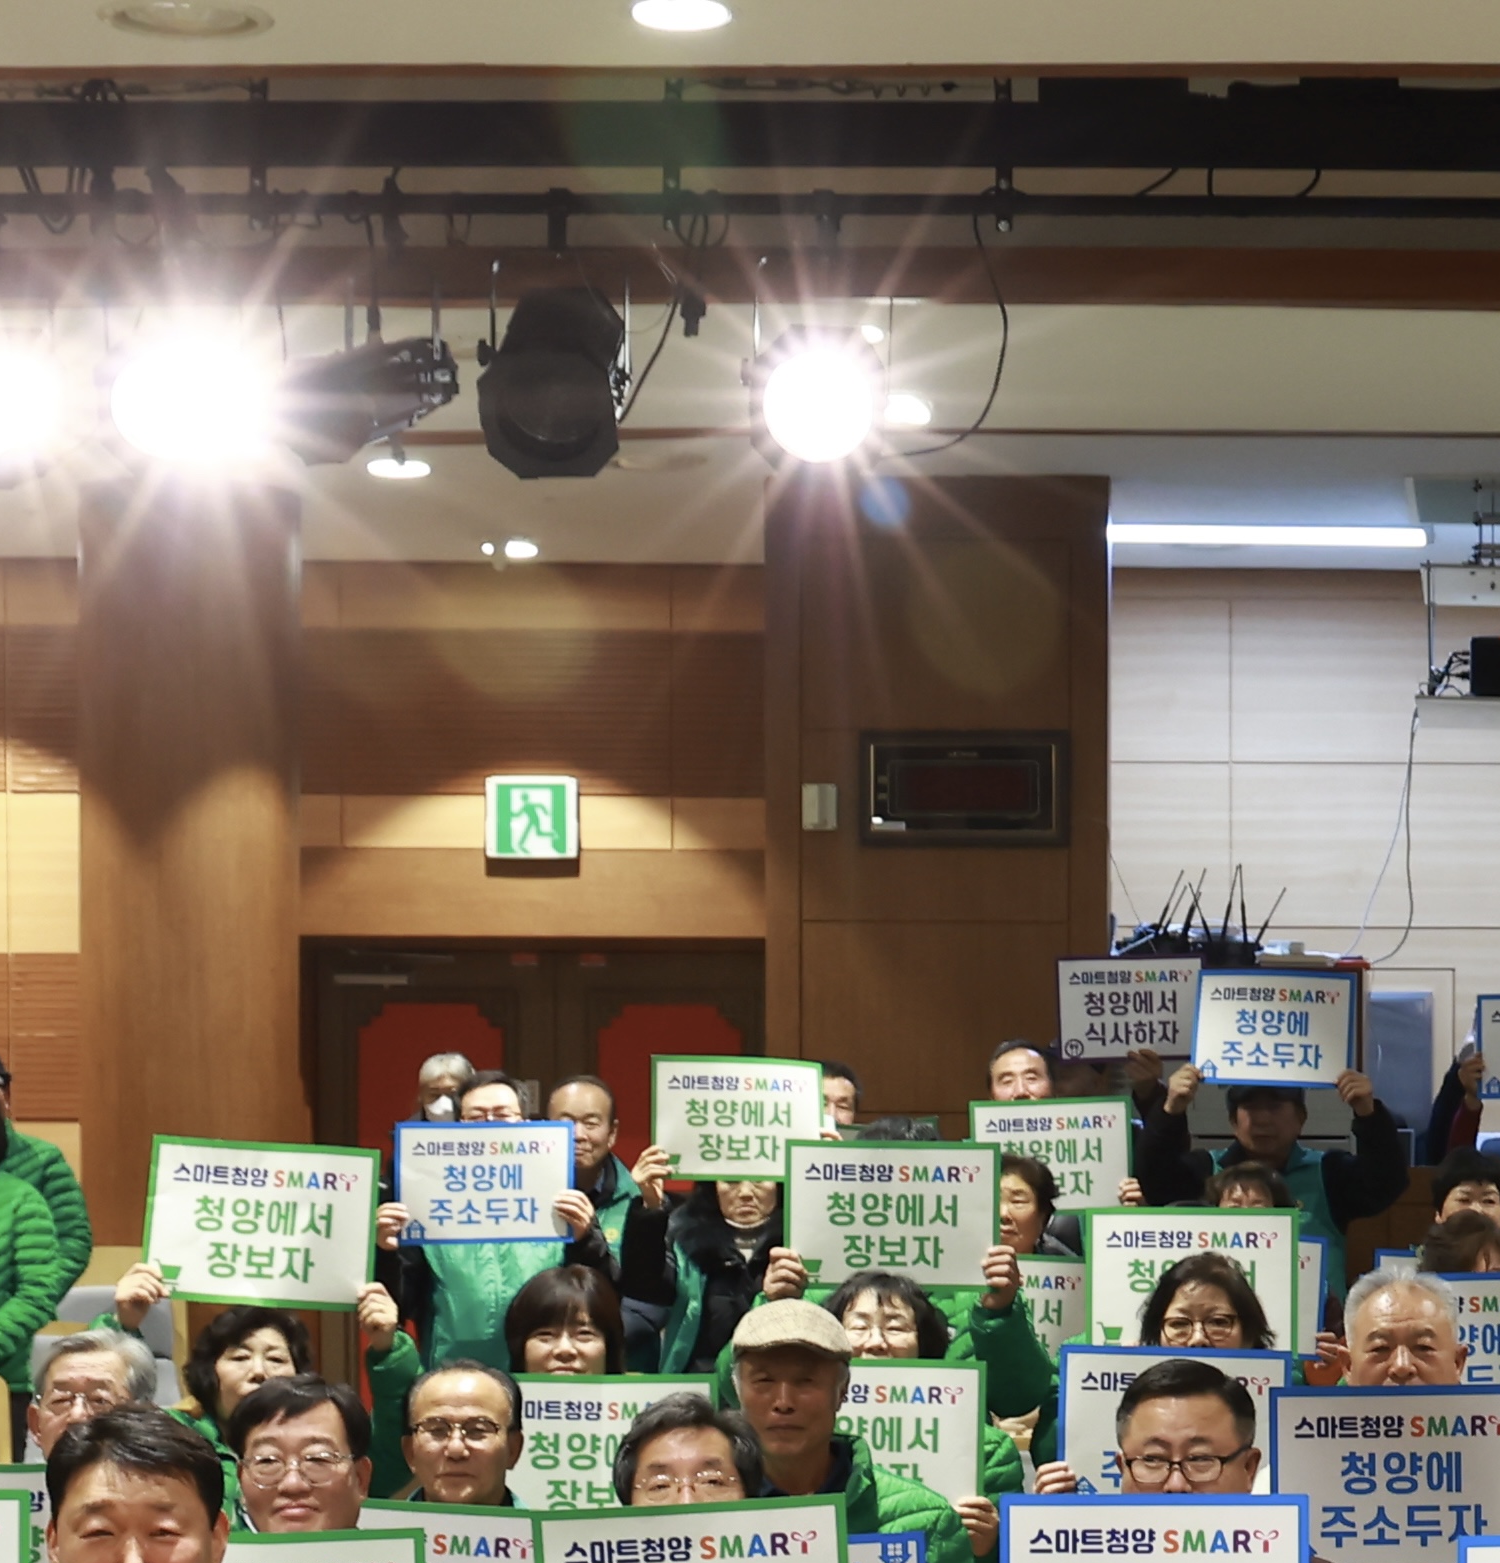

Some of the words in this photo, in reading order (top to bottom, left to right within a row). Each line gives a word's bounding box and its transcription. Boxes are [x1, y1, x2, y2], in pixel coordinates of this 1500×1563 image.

[1069, 971, 1131, 985] 스마트청양
[1084, 990, 1177, 1016] 청양에서
[1212, 987, 1276, 1002] 스마트청양
[1085, 1020, 1179, 1046] 식사하자
[1237, 1009, 1309, 1037] 청양에
[1222, 1042, 1321, 1071] 주소두자
[668, 1075, 739, 1090] 스마트청양
[685, 1098, 791, 1128] 청양에서
[986, 1117, 1052, 1133] 스마트청양
[412, 1141, 485, 1156] 스마트청양
[698, 1134, 780, 1162] 장보자
[174, 1163, 268, 1187] 스마트청양
[444, 1164, 522, 1192] 청양에
[806, 1164, 893, 1182] 스마트청양
[195, 1195, 334, 1238] 청양에서
[428, 1197, 539, 1226] 주소두자
[827, 1192, 957, 1227] 청양에서
[844, 1235, 944, 1269] 장보자
[1107, 1231, 1192, 1248] 스마트청양
[207, 1242, 313, 1284] 장보자
[1295, 1415, 1404, 1439] 스마트청양
[1341, 1451, 1462, 1495] 청양에
[1321, 1504, 1487, 1549] 주소두자
[1030, 1528, 1156, 1554] 스마트청양
